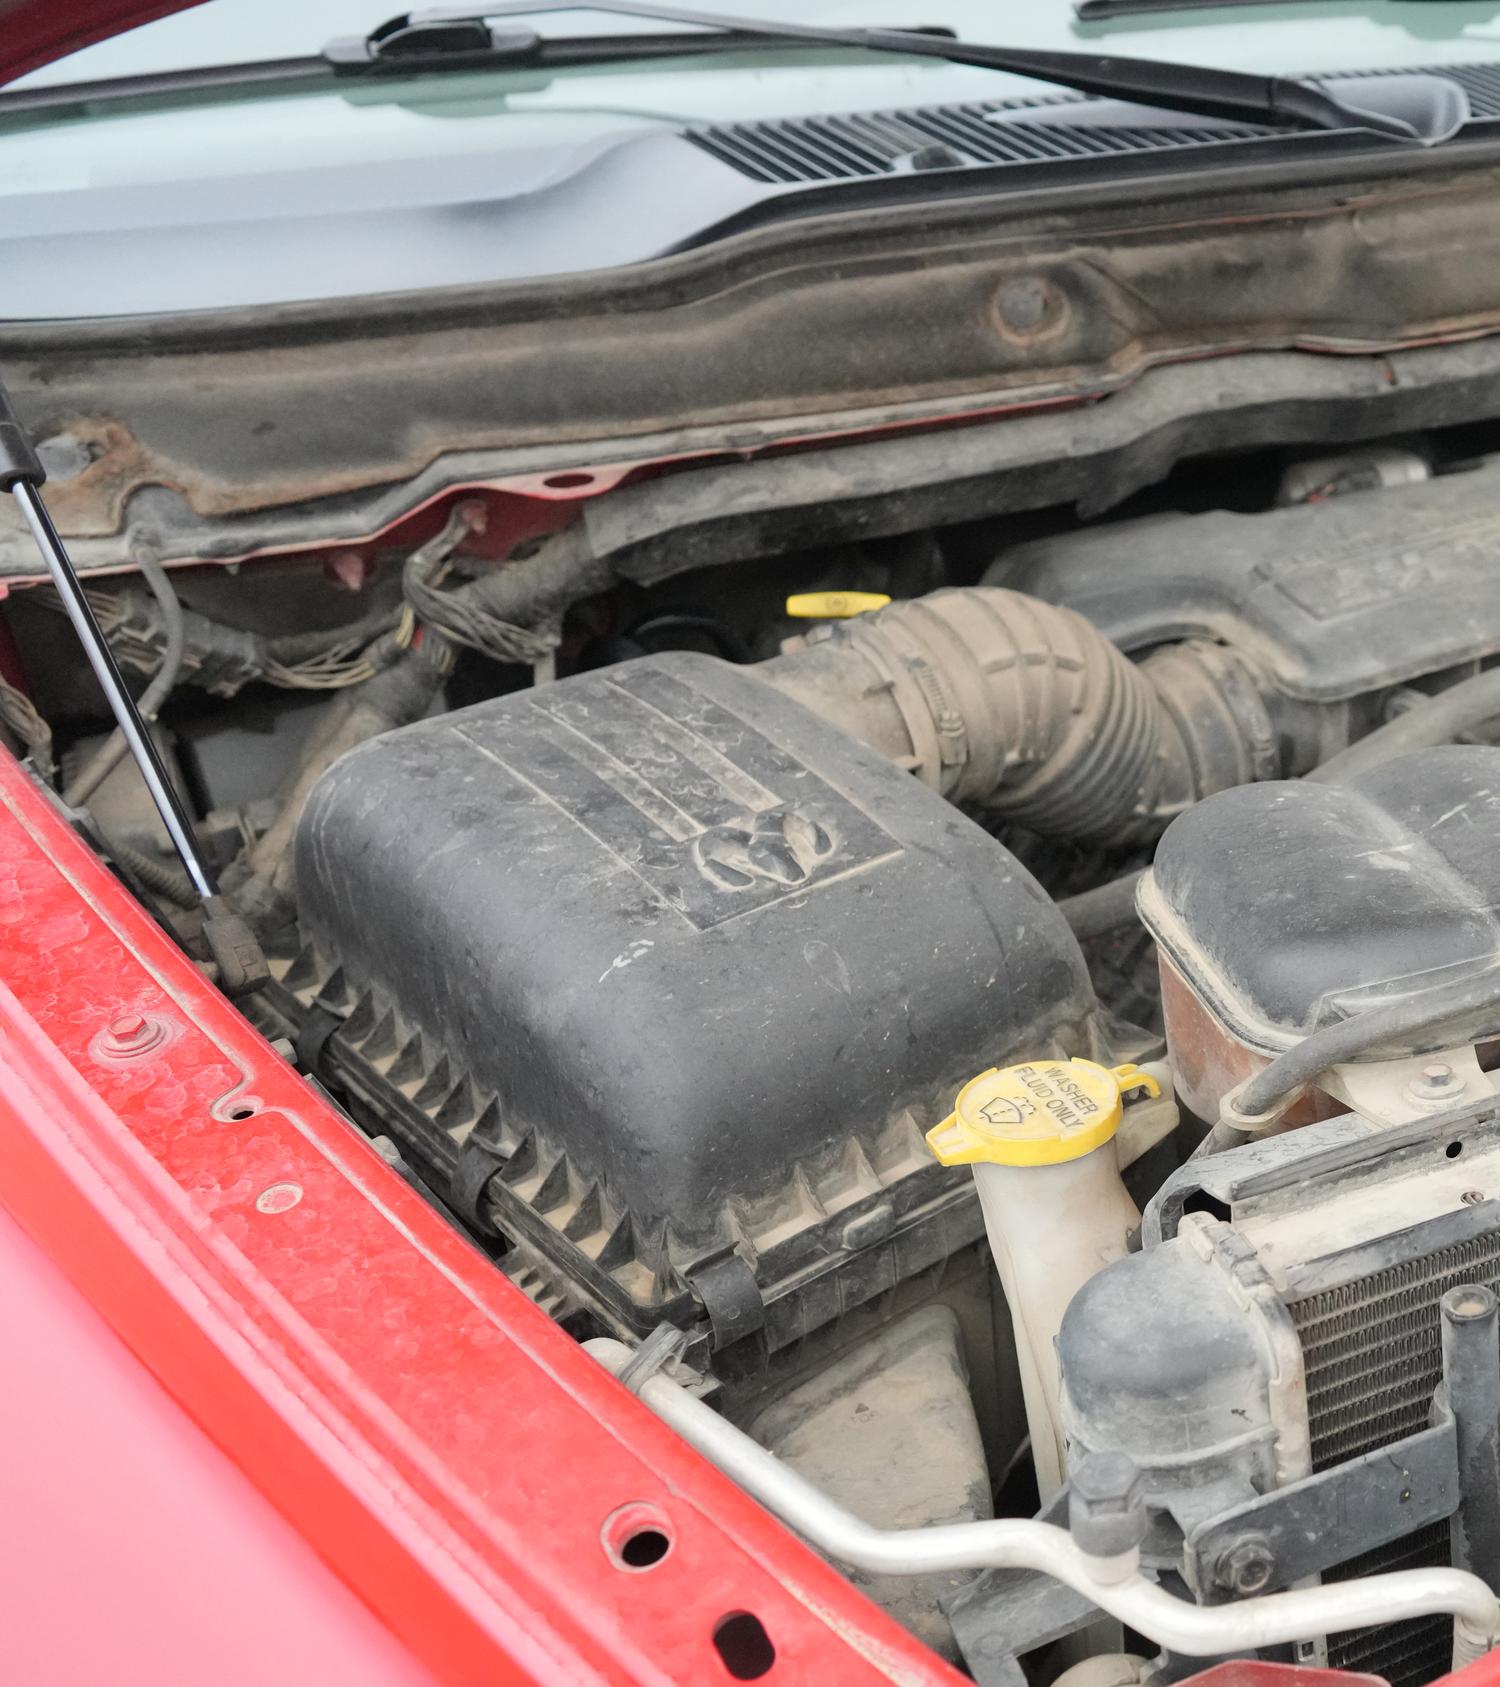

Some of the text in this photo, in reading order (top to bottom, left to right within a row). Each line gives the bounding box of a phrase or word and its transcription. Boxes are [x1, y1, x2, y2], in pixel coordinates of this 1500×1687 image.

[1015, 1066, 1087, 1129] FLUID ONLY
[1043, 1066, 1100, 1115] WASHER
